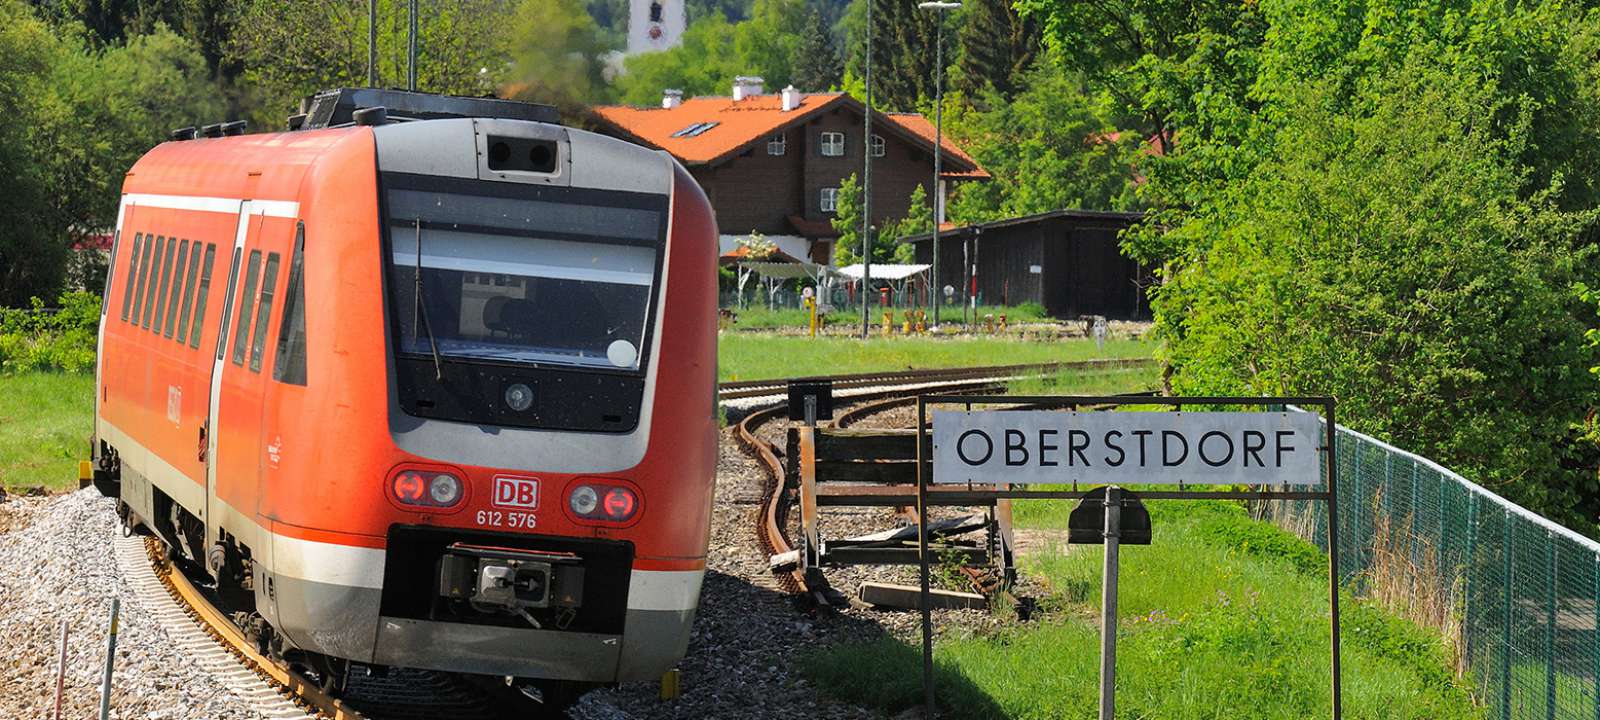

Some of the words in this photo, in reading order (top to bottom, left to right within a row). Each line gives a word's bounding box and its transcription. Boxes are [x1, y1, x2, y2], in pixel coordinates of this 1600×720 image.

[957, 429, 1295, 467] OBERSTDORF
[498, 481, 534, 504] DB
[477, 510, 502, 526] 612
[508, 512, 536, 528] 576
